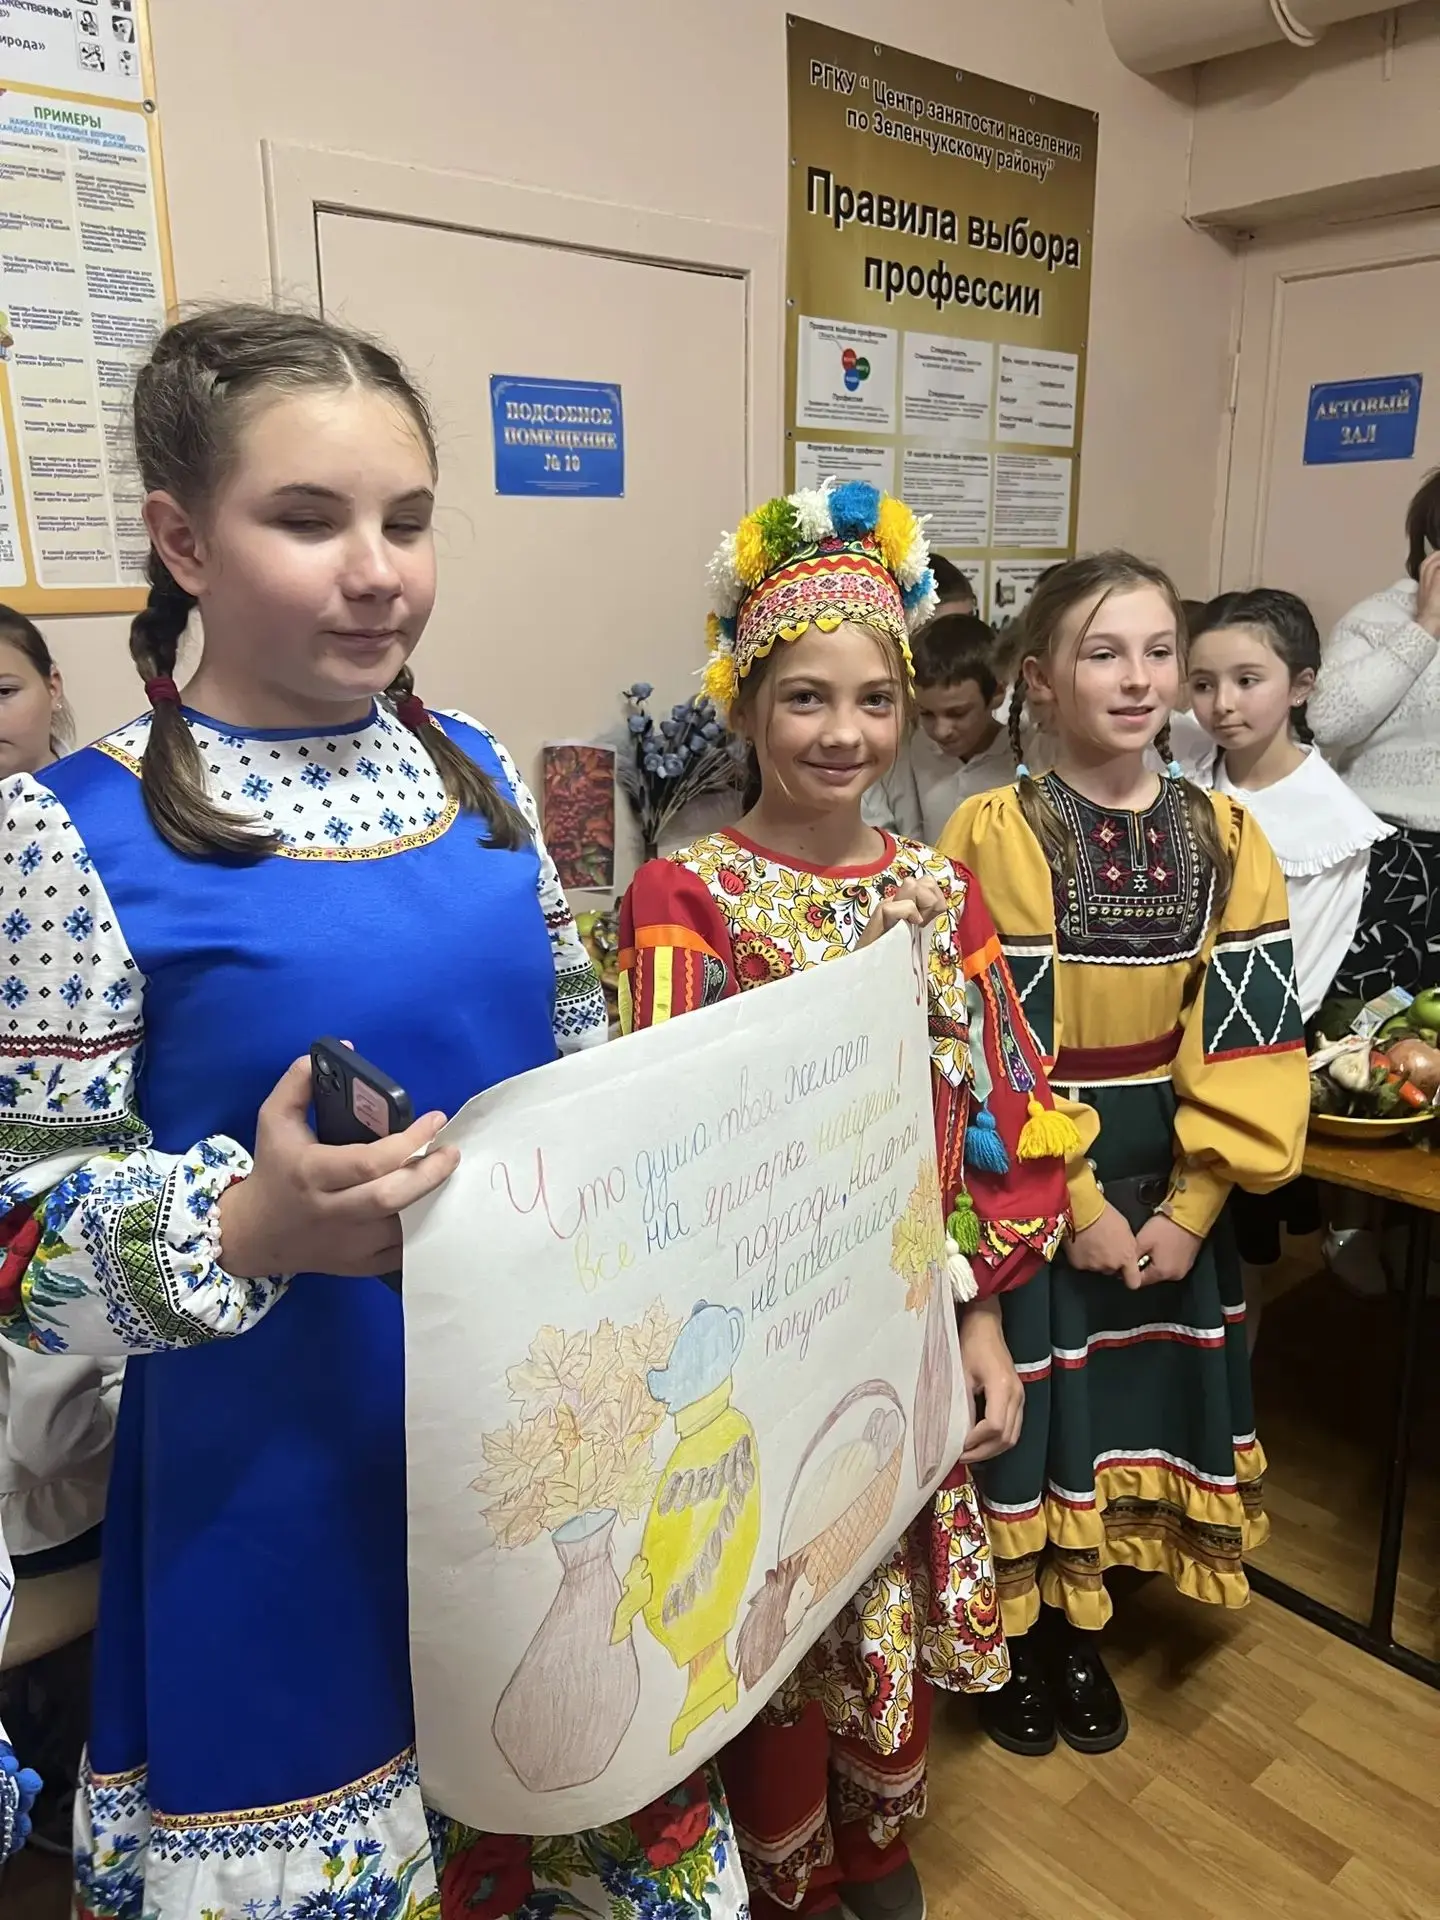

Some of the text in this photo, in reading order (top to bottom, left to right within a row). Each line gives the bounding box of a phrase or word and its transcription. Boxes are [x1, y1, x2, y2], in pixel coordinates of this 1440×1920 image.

[34, 107, 101, 129] ПРИМЕРЫ
[810, 60, 856, 94] РГКУ
[873, 79, 924, 118] Центр
[927, 101, 1006, 139] занятости
[1008, 124, 1081, 160] населения
[847, 109, 869, 130] по
[873, 109, 992, 168] Зеленчукскому
[807, 166, 1081, 272] Правила выбора
[864, 256, 1041, 317] профессии
[505, 401, 613, 426] ПОДСОБНОЕ
[1315, 388, 1411, 421] АКТОВЫЙ
[1341, 423, 1377, 445] ЗАЛ
[504, 427, 617, 451] ПОМЕЩЕНИЕ
[544, 453, 580, 471] № 10
[491, 1035, 869, 1239] Что душа твоя желает
[848, 1112, 920, 1196] налетай
[646, 1201, 691, 1254] на
[701, 1140, 808, 1247] ярмарке
[751, 1187, 899, 1321] не стесняйся
[766, 1276, 851, 1361] покупай
